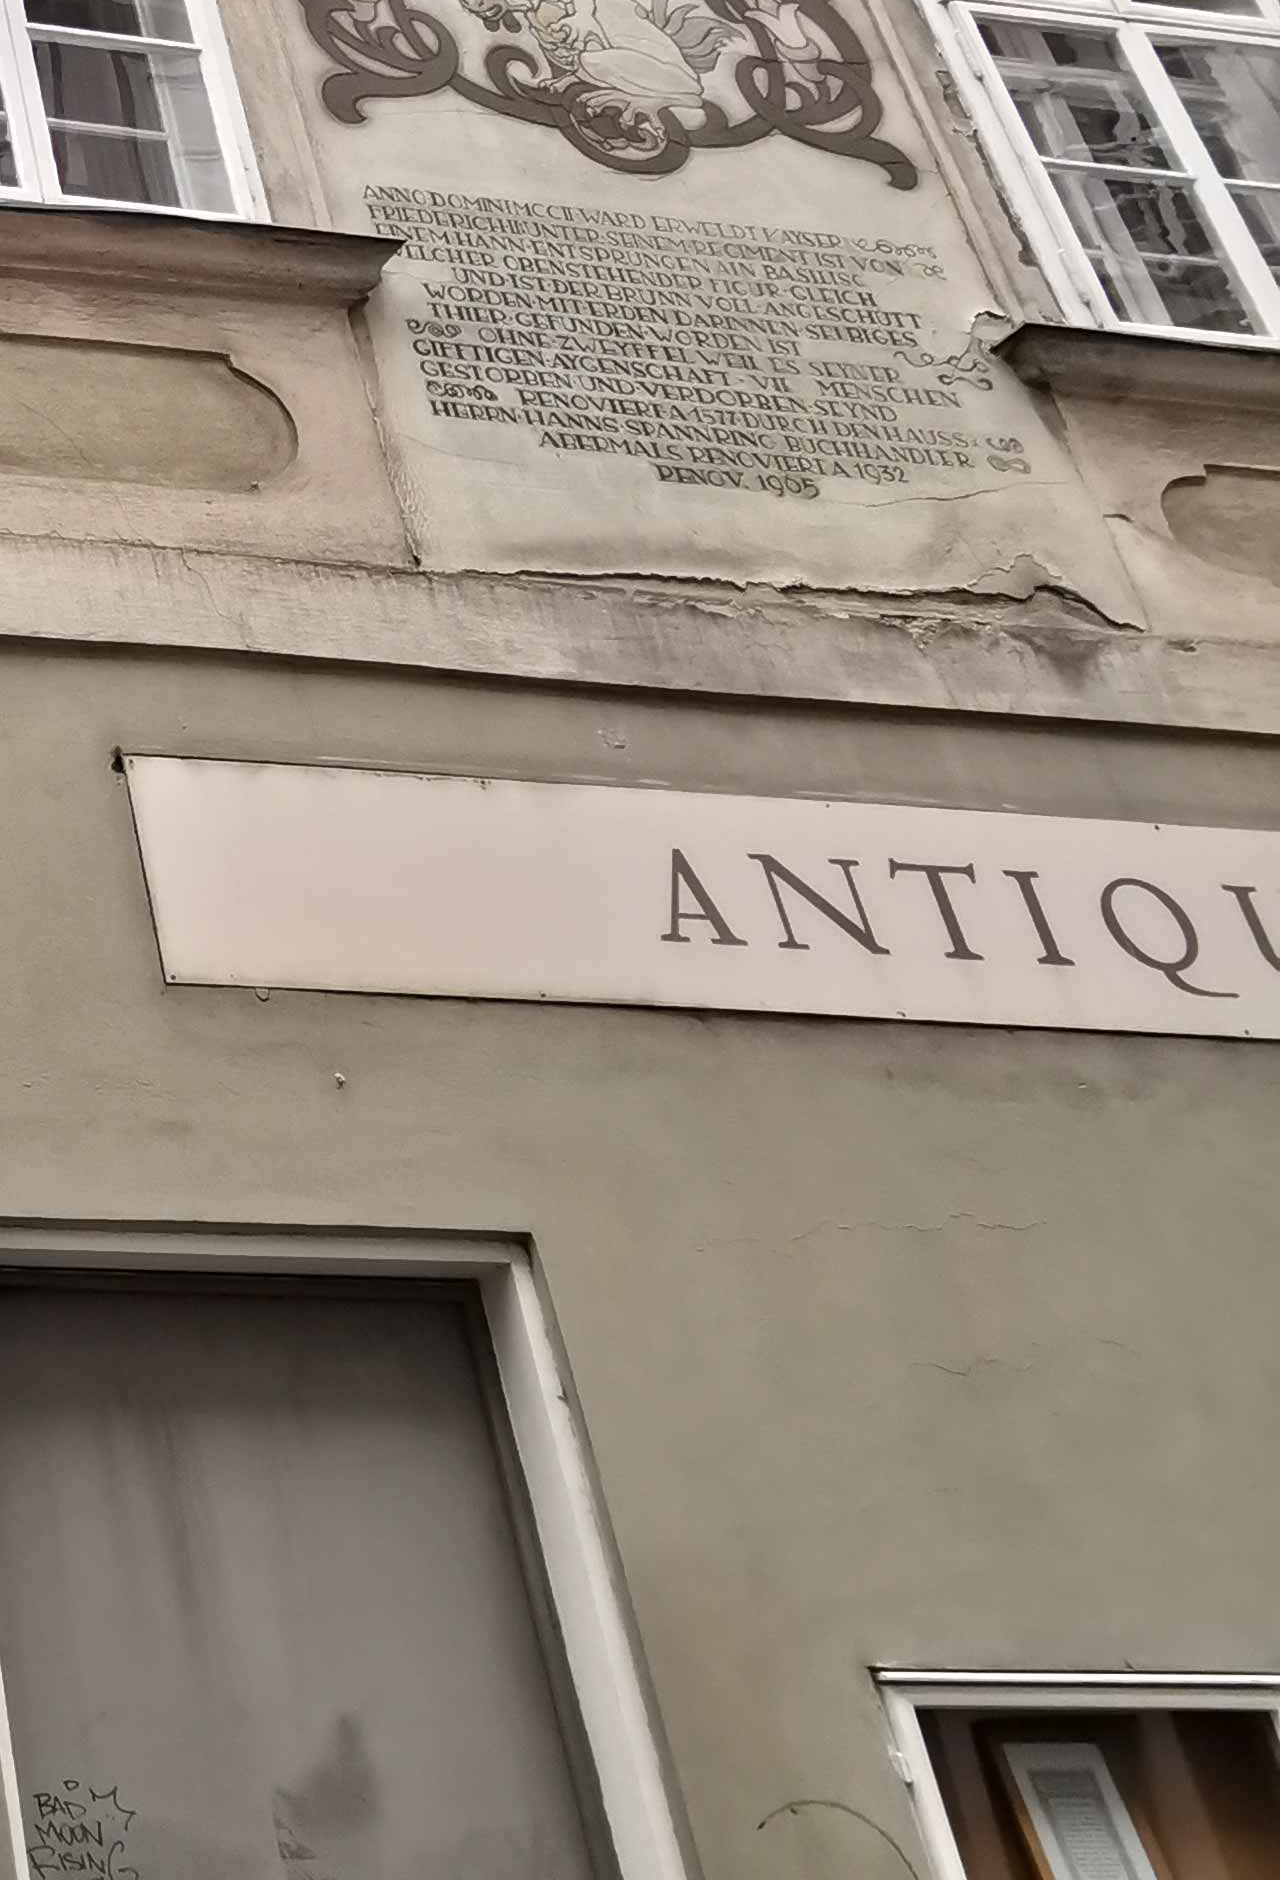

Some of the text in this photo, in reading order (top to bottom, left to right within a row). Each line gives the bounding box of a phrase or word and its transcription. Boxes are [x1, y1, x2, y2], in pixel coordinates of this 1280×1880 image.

[363, 184, 427, 206] ANNO
[430, 191, 512, 215] DOMINI
[578, 208, 645, 230] WARD
[366, 204, 507, 233] FRIEDERICH
[523, 222, 600, 242] UNTER
[606, 230, 687, 253] SEINEM
[814, 251, 845, 269] IST
[850, 255, 904, 276] VON
[456, 232, 525, 255] HANN
[717, 261, 756, 278] AIN
[453, 267, 506, 287] UND
[511, 272, 547, 292] IST
[554, 278, 602, 299] DER
[606, 284, 692, 308] BRUNN
[695, 294, 759, 314] VOLL
[503, 255, 702, 290] OBENSTEHENDER
[790, 284, 878, 307] GLEICH
[423, 282, 532, 308] WORDEN
[539, 295, 583, 315] MIT
[588, 301, 669, 325] ERDEN
[672, 310, 799, 338] DARINNEN
[427, 302, 801, 357] THIER GEFUNDEN WORDEN IST
[412, 339, 546, 367] GIFFTIGEN
[552, 353, 730, 386] AYGENSCHAFT
[816, 380, 962, 409] MENSCHEN
[478, 326, 551, 349] OHNE
[555, 335, 696, 364] ZWEYFFEL
[768, 357, 801, 375] ES
[808, 361, 900, 383] SEYNER
[420, 360, 897, 422] GESTORBEN UND VERDORBEN SEYND
[428, 399, 518, 424] HERRN
[523, 408, 619, 433] HANNS
[742, 412, 828, 434] DURCH
[833, 422, 881, 439] DEN
[539, 431, 910, 485] ABERMALS RENOVIERT A 1932
[33, 1820, 103, 1847] MOON
